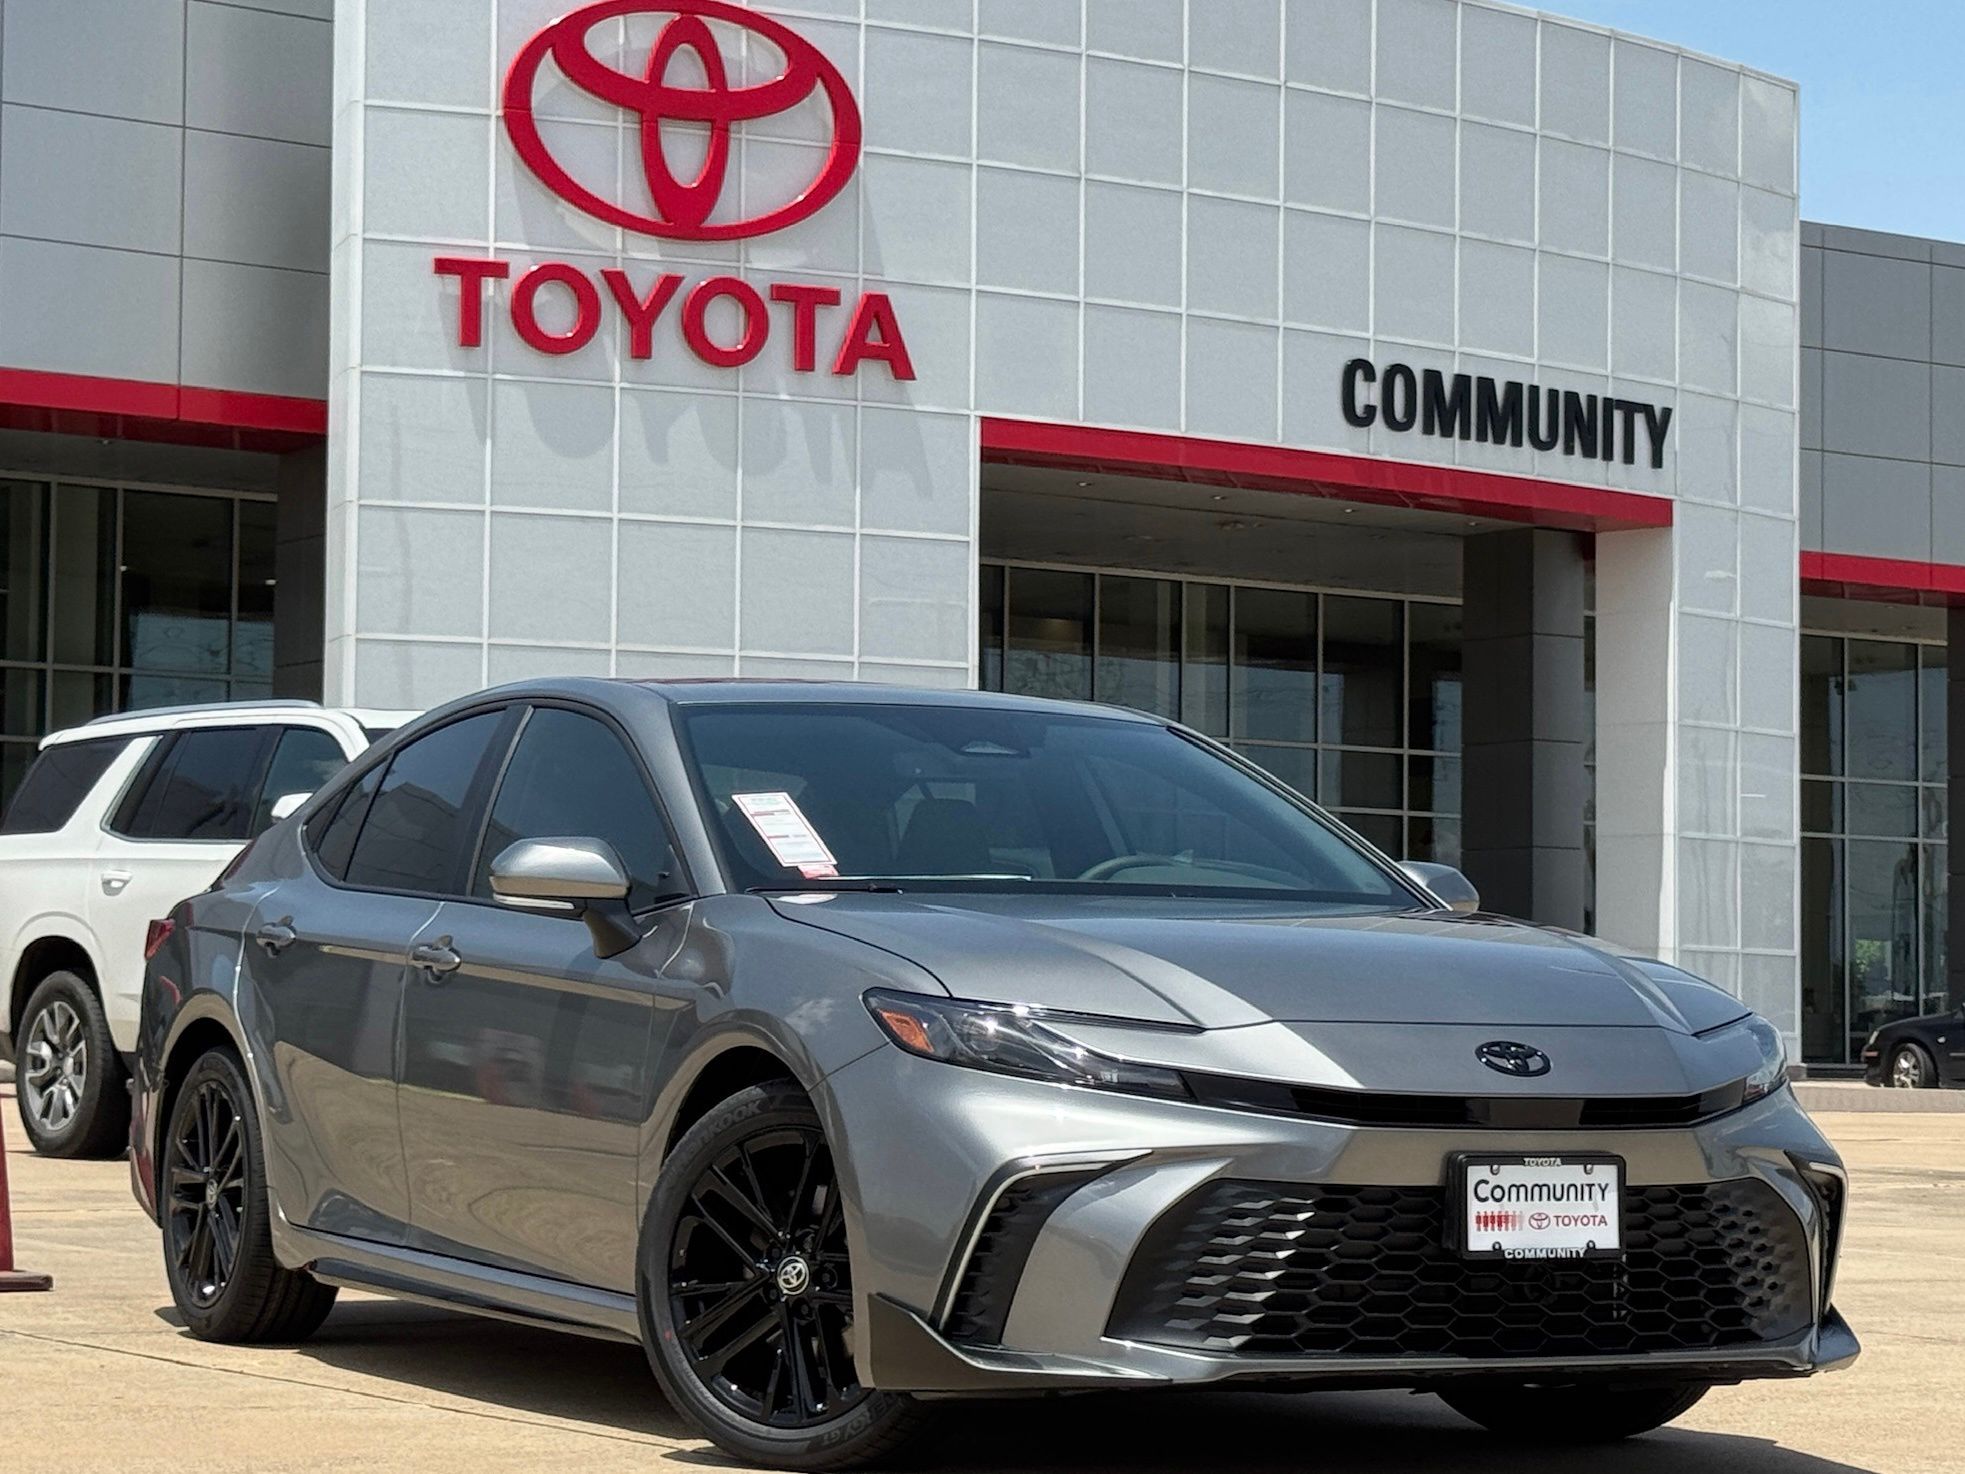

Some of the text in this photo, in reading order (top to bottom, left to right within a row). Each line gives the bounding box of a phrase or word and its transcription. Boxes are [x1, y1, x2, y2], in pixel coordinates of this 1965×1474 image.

[434, 257, 916, 381] TOYOTA
[1341, 358, 1673, 469] COMMUNITY
[1523, 1157, 1562, 1167] TOYOTA
[1553, 1214, 1608, 1228] TOYOTA
[1504, 1247, 1586, 1259] COMMUNITY
